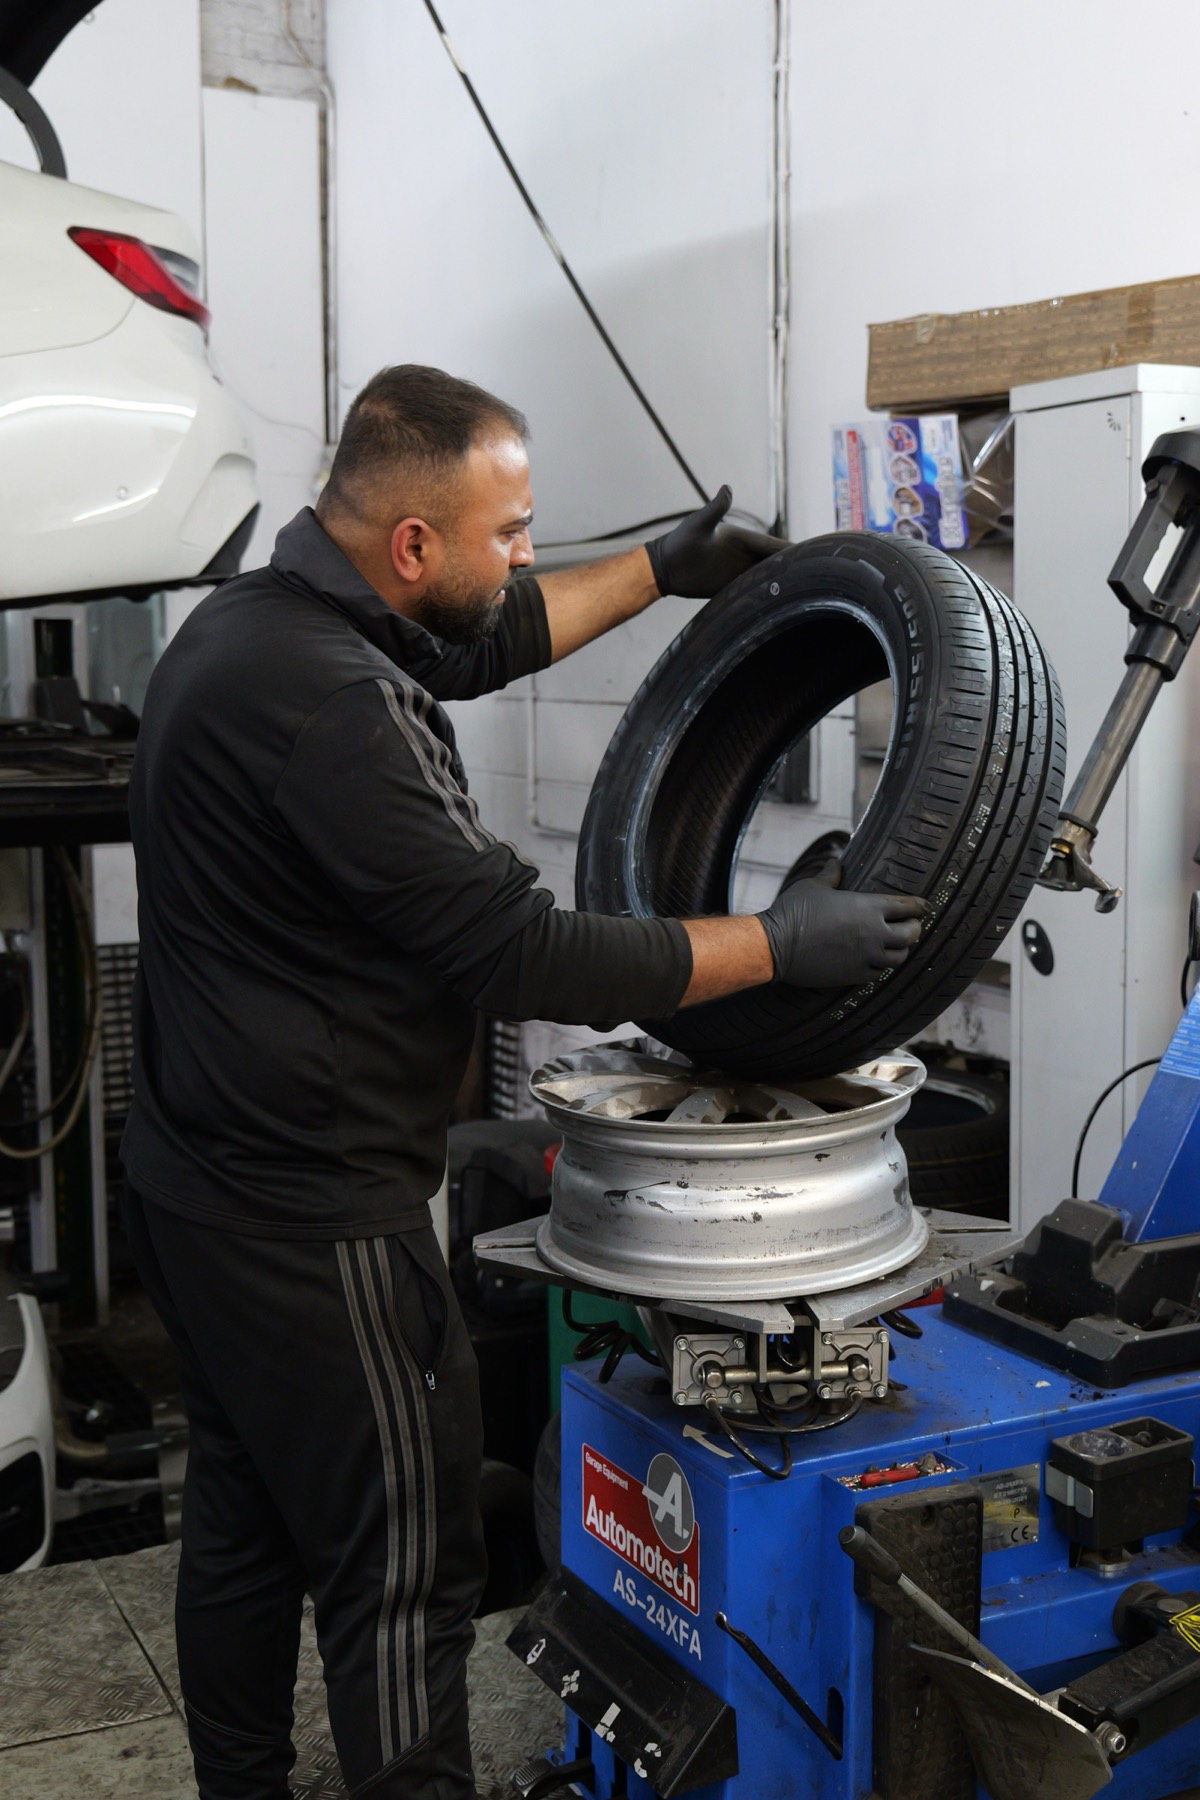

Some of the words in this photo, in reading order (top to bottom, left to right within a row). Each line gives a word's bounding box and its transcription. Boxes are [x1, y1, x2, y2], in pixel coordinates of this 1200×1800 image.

[585, 1452, 602, 1473] Garage
[602, 1463, 629, 1491] Equipment
[586, 1494, 696, 1608] Automotech
[1010, 1524, 1030, 1543] CE
[612, 1569, 702, 1662] AS-24XFA
